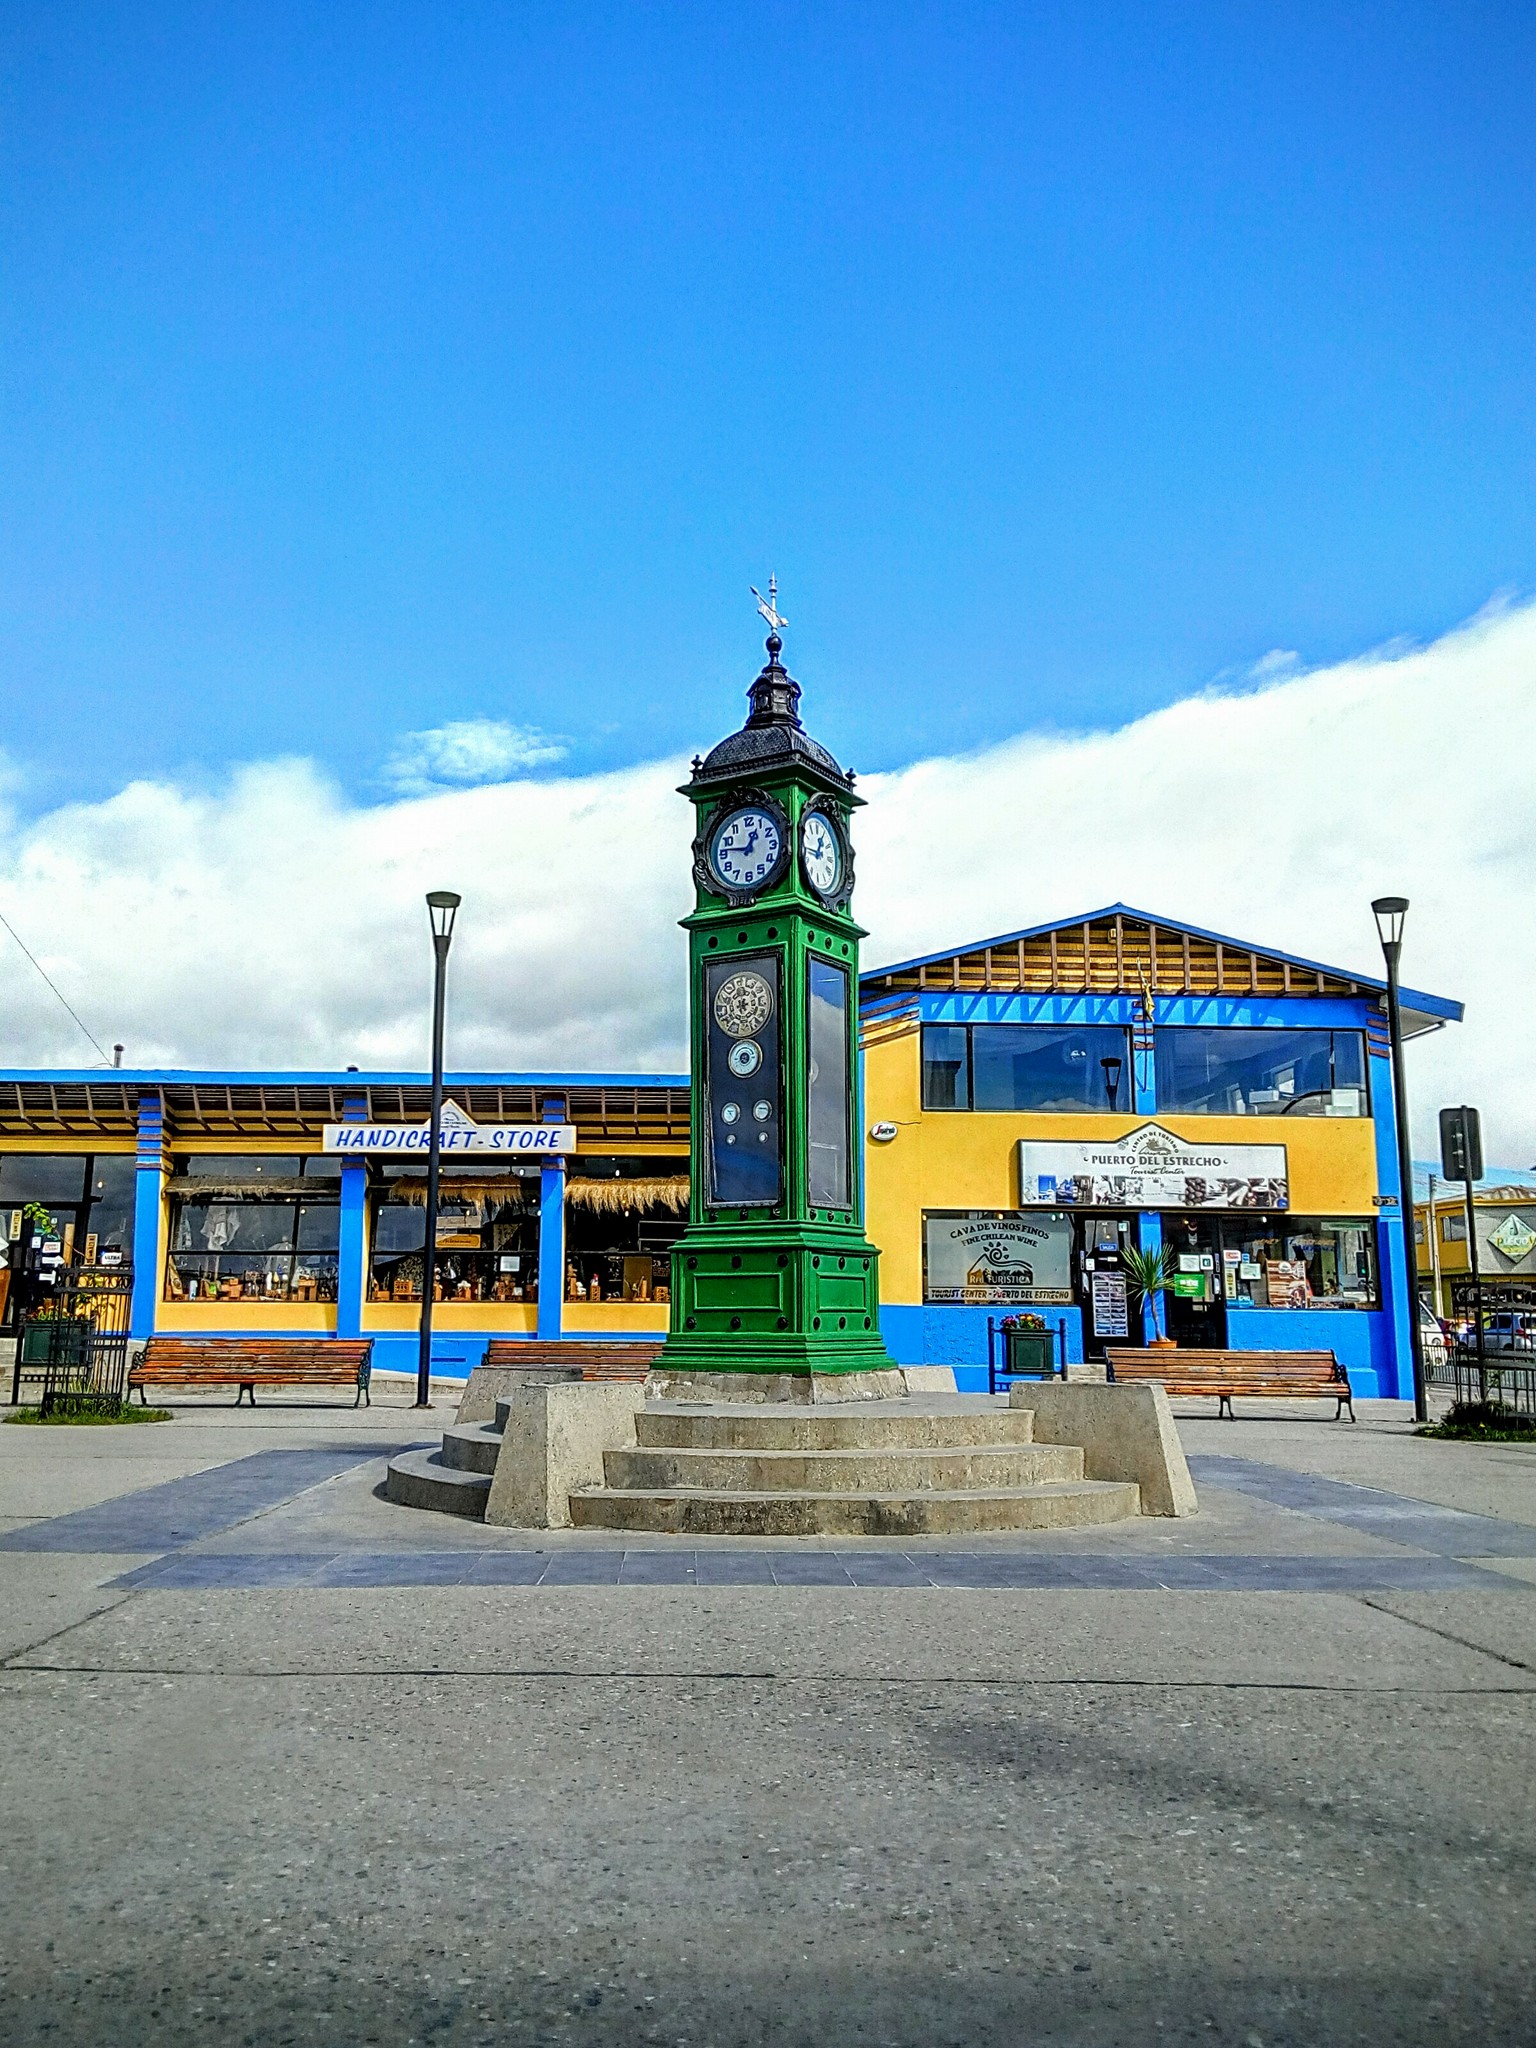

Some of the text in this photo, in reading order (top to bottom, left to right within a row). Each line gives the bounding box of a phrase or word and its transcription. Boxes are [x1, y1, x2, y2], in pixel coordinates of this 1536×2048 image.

[744, 816, 755, 827] 12
[758, 819, 762, 829] 1
[732, 824, 739, 834] 11
[765, 827, 773, 838] 2
[723, 837, 733, 846] 10
[769, 840, 777, 850] 3
[719, 849, 728, 859] 9
[766, 853, 775, 863] 4
[724, 862, 732, 872] 8
[757, 864, 765, 875] 5
[733, 869, 741, 881] 7
[745, 871, 753, 882] 6
[336, 1130, 477, 1148] HANDICRAFT
[489, 1131, 562, 1149] STORE
[1092, 1155, 1221, 1166] PUERTO DEL ESTRECHO
[1130, 1166, 1158, 1174] Tourist
[950, 1222, 1050, 1240] CAVA DE VINOS FINOS
[962, 1236, 980, 1246] FINE
[1017, 1236, 1038, 1247] WINE
[932, 1290, 960, 1298] TOURIST
[961, 1290, 986, 1298] CENTER
[993, 1290, 1019, 1298] PUERTO
[1021, 1290, 1032, 1298] DEL
[1035, 1291, 1069, 1299] ESTRECHO
